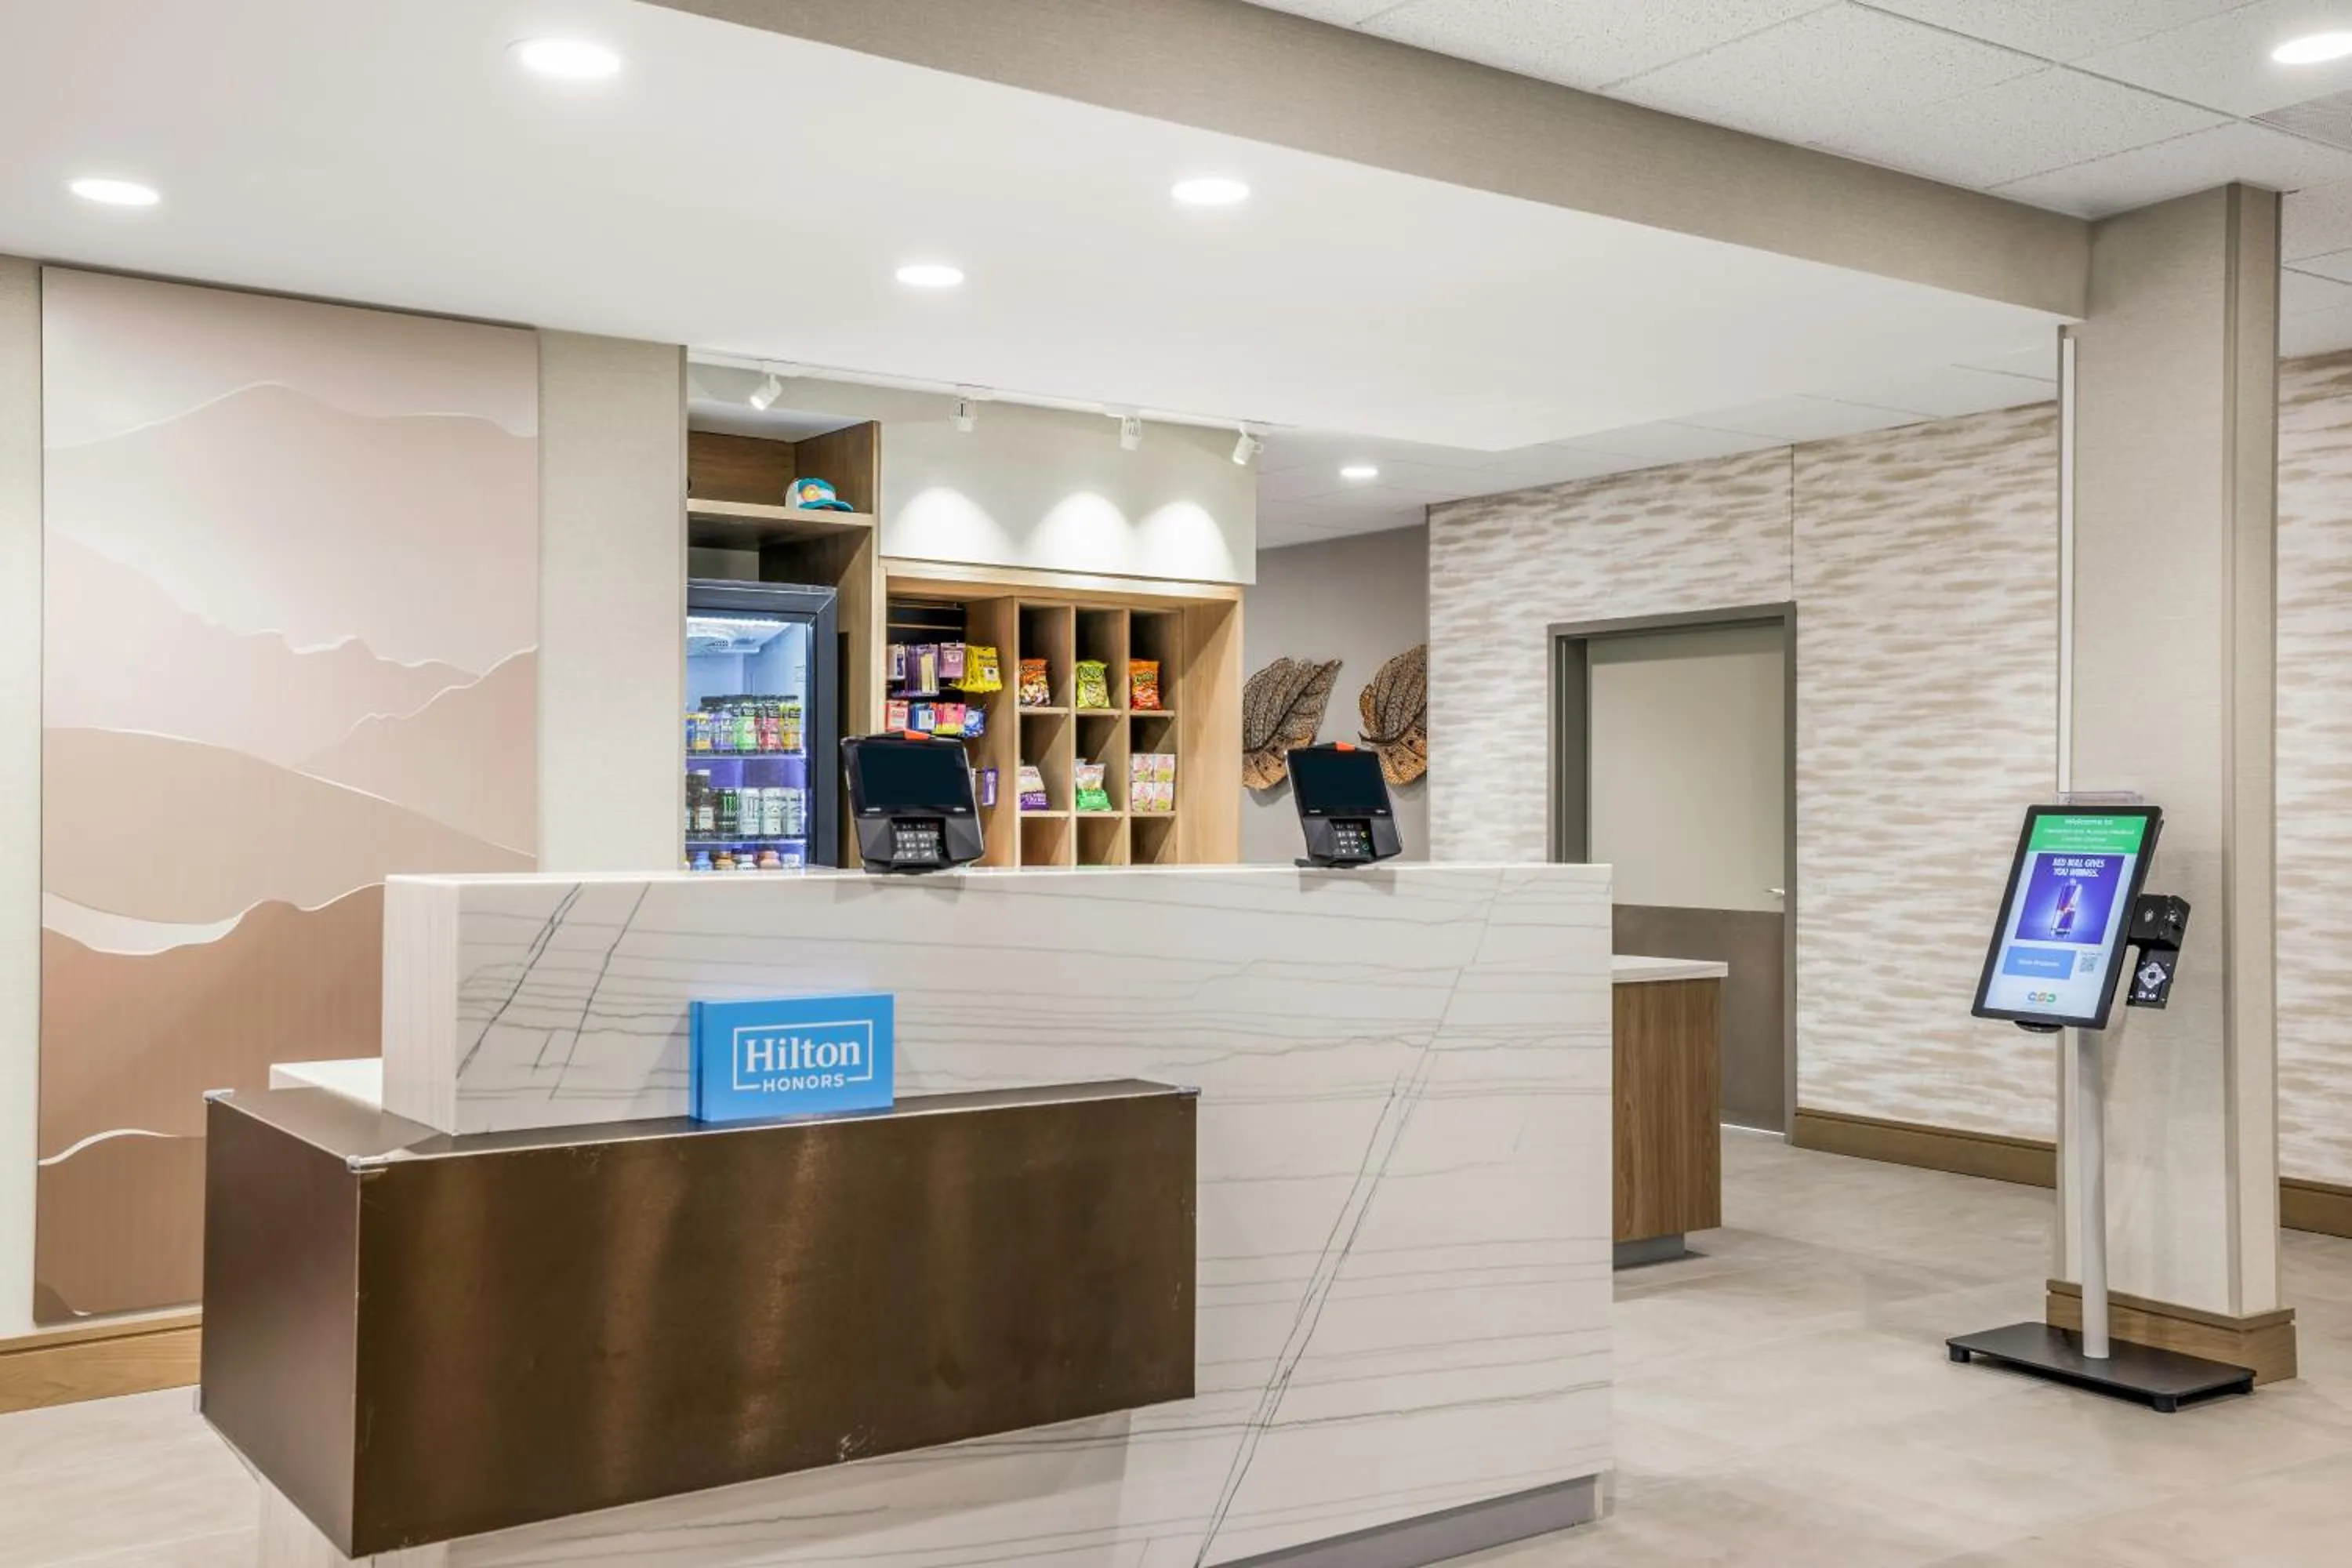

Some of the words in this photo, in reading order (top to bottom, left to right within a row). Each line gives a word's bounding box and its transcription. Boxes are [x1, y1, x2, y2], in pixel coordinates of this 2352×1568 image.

[2085, 858, 2105, 867] GIVES
[746, 1036, 862, 1073] Hilton
[763, 1073, 845, 1092] HONORS
